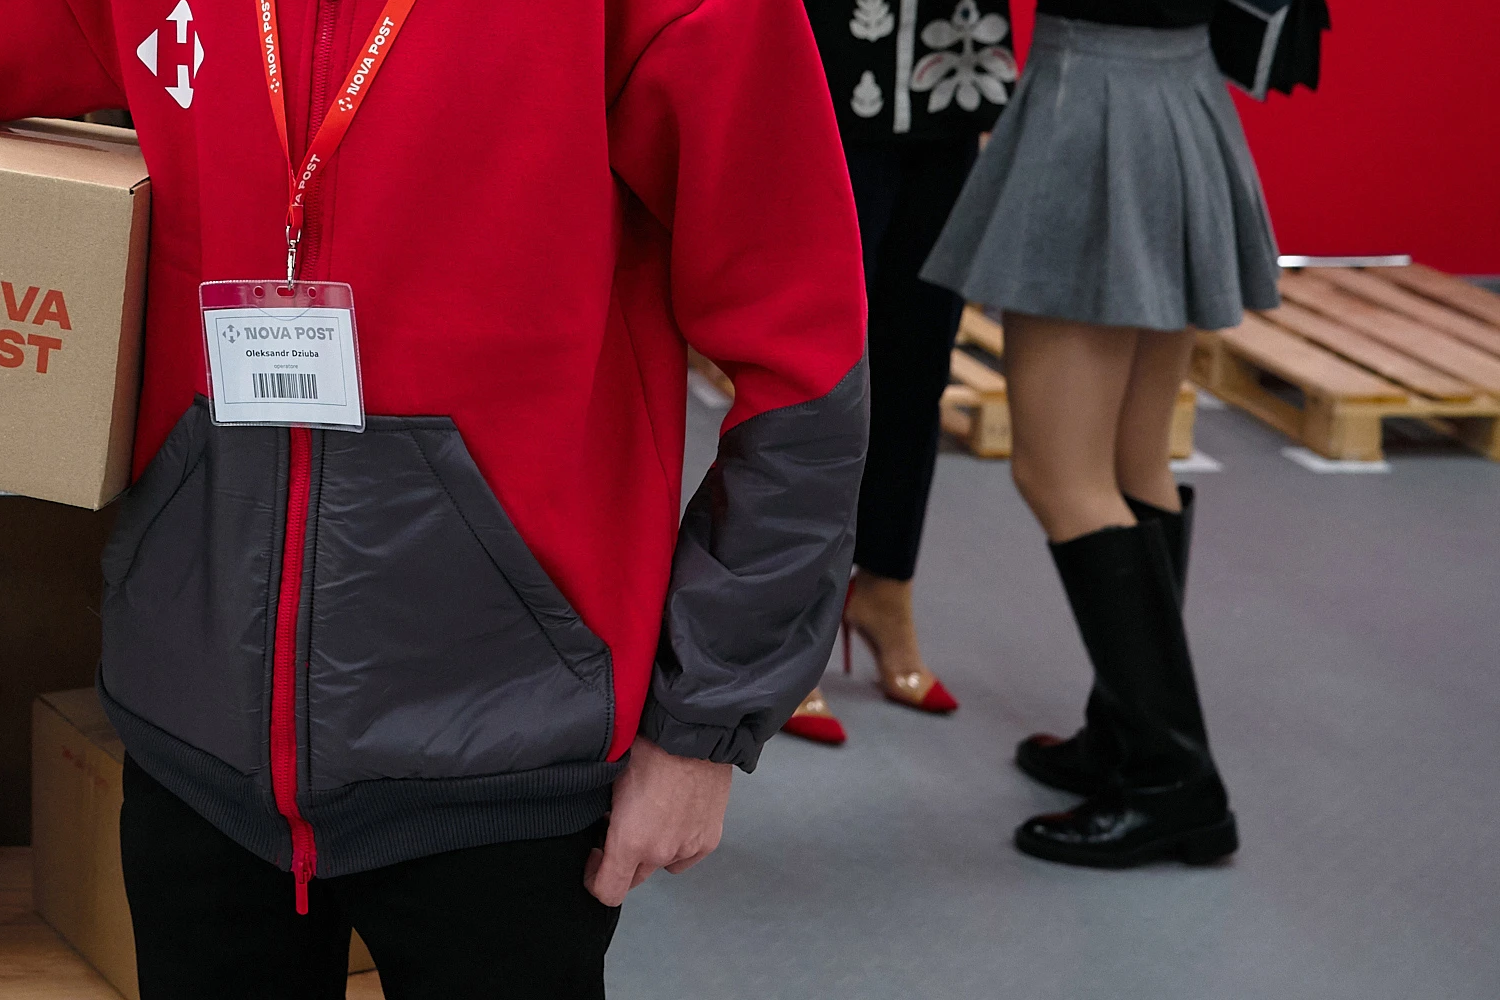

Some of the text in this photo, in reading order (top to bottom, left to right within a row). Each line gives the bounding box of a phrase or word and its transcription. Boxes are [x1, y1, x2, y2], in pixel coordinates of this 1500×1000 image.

[264, 34, 277, 76] NOVA
[347, 16, 394, 96] NOVA POST
[298, 153, 320, 189] POST
[243, 326, 335, 341] NOVA POST
[245, 349, 319, 358] Oleksandr Dziuba
